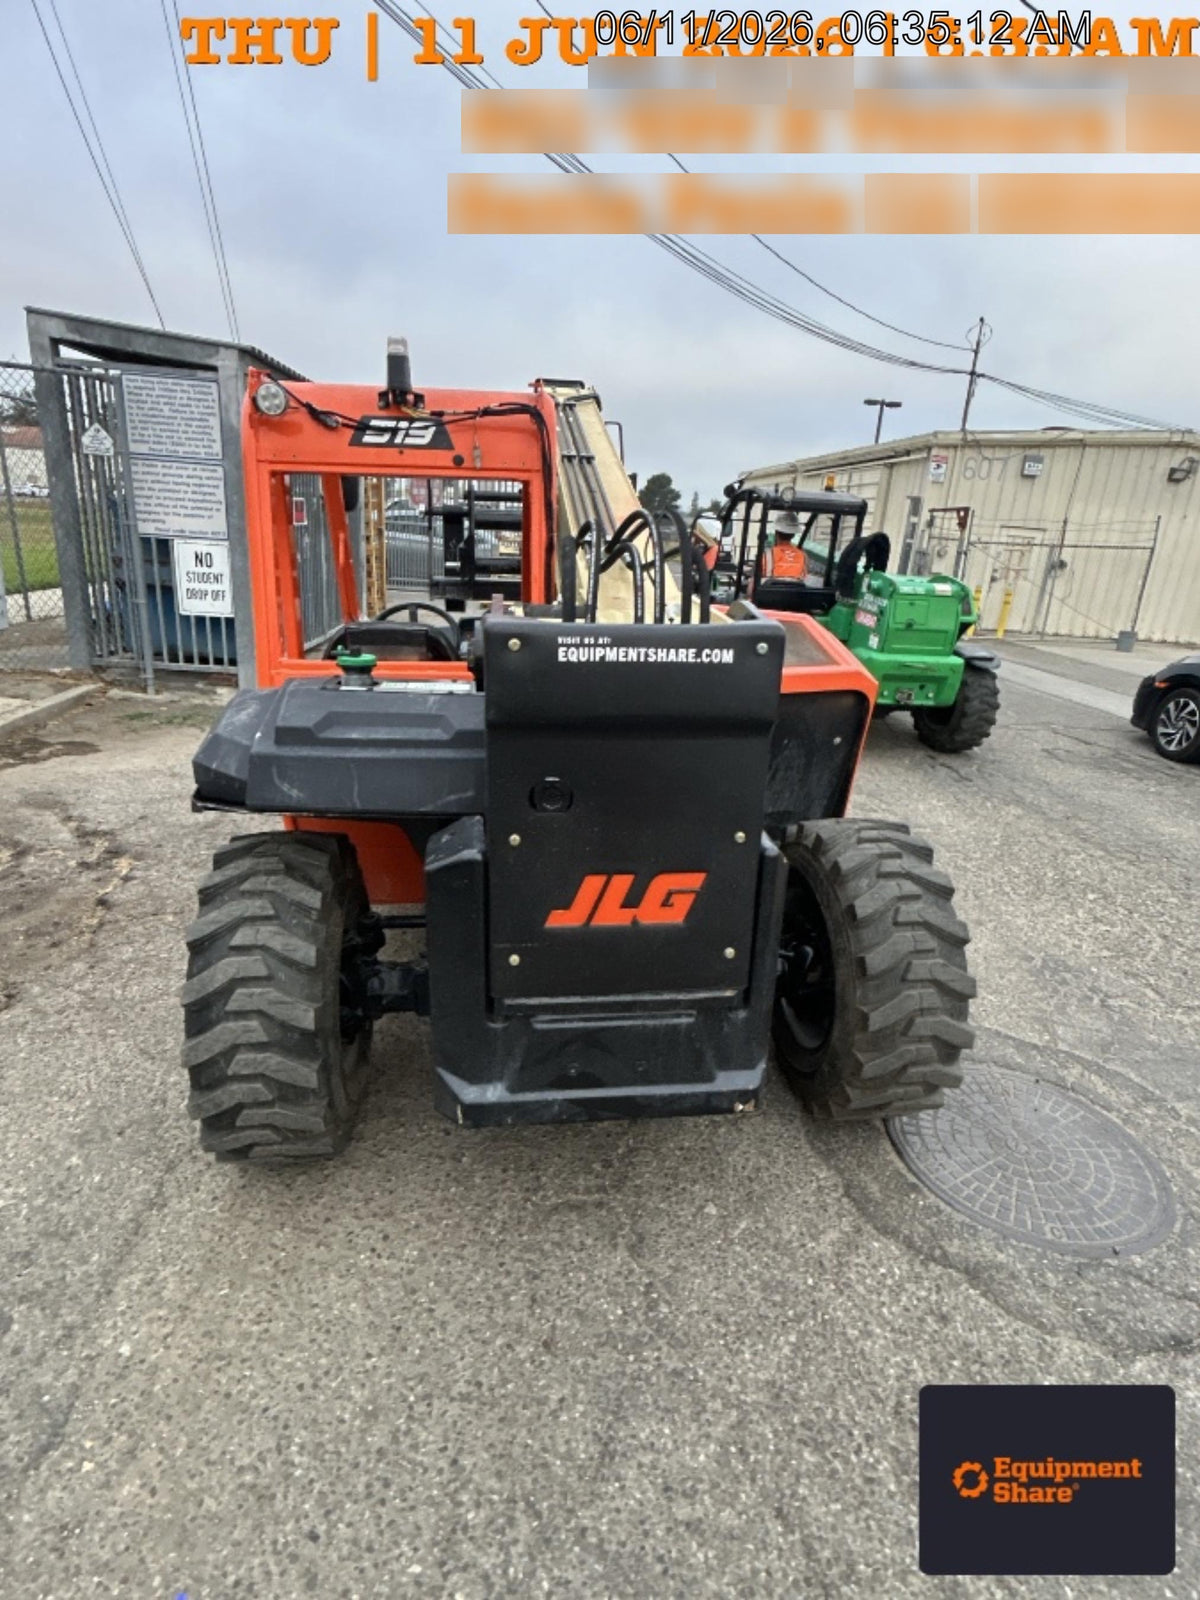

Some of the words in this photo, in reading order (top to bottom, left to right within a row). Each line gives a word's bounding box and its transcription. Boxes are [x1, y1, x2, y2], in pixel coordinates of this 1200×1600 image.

[362, 419, 437, 446] 519
[194, 551, 214, 568] NO
[186, 571, 224, 584] STUDENT
[186, 588, 209, 601] DROP
[211, 590, 226, 602] OFF
[557, 646, 734, 664] EQUIPMENTSHARE.COM
[543, 872, 708, 928] JLG
